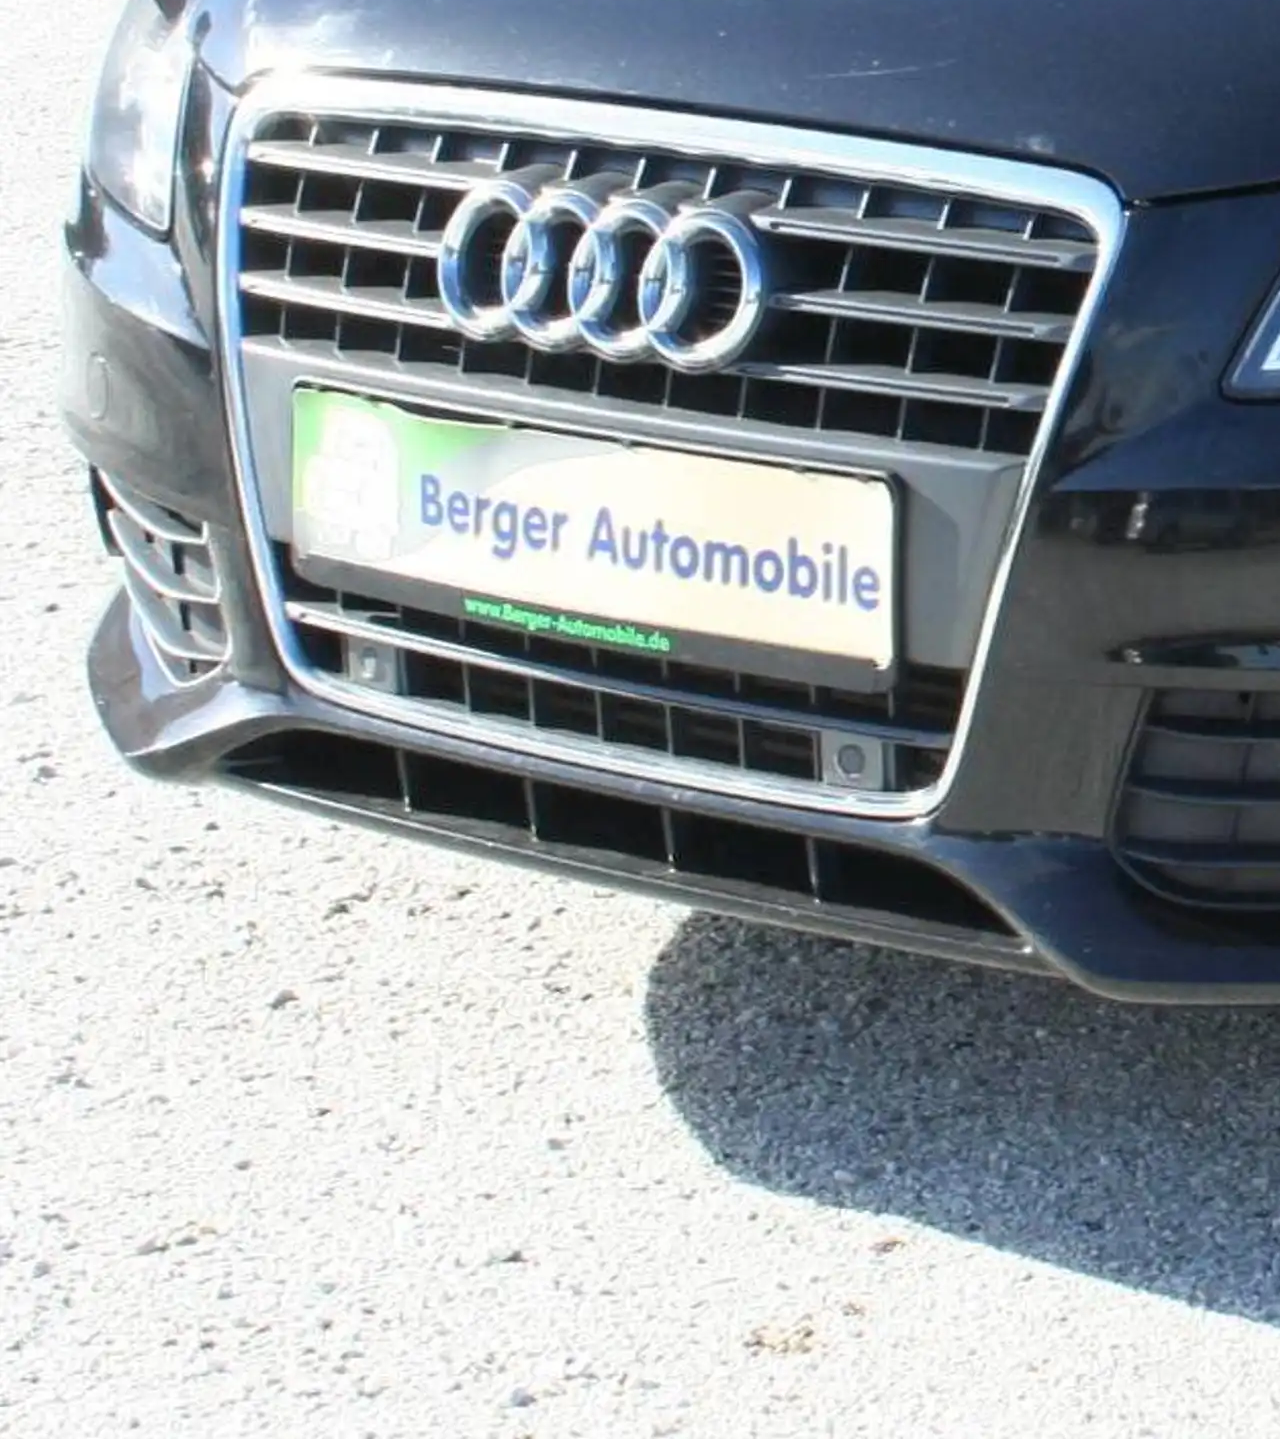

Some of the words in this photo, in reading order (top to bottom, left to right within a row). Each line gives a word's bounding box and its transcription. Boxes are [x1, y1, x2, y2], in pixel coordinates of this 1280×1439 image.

[419, 475, 568, 559] Berger
[586, 507, 881, 609] Automobile
[464, 597, 670, 652] www.Berger-Automobile.de
